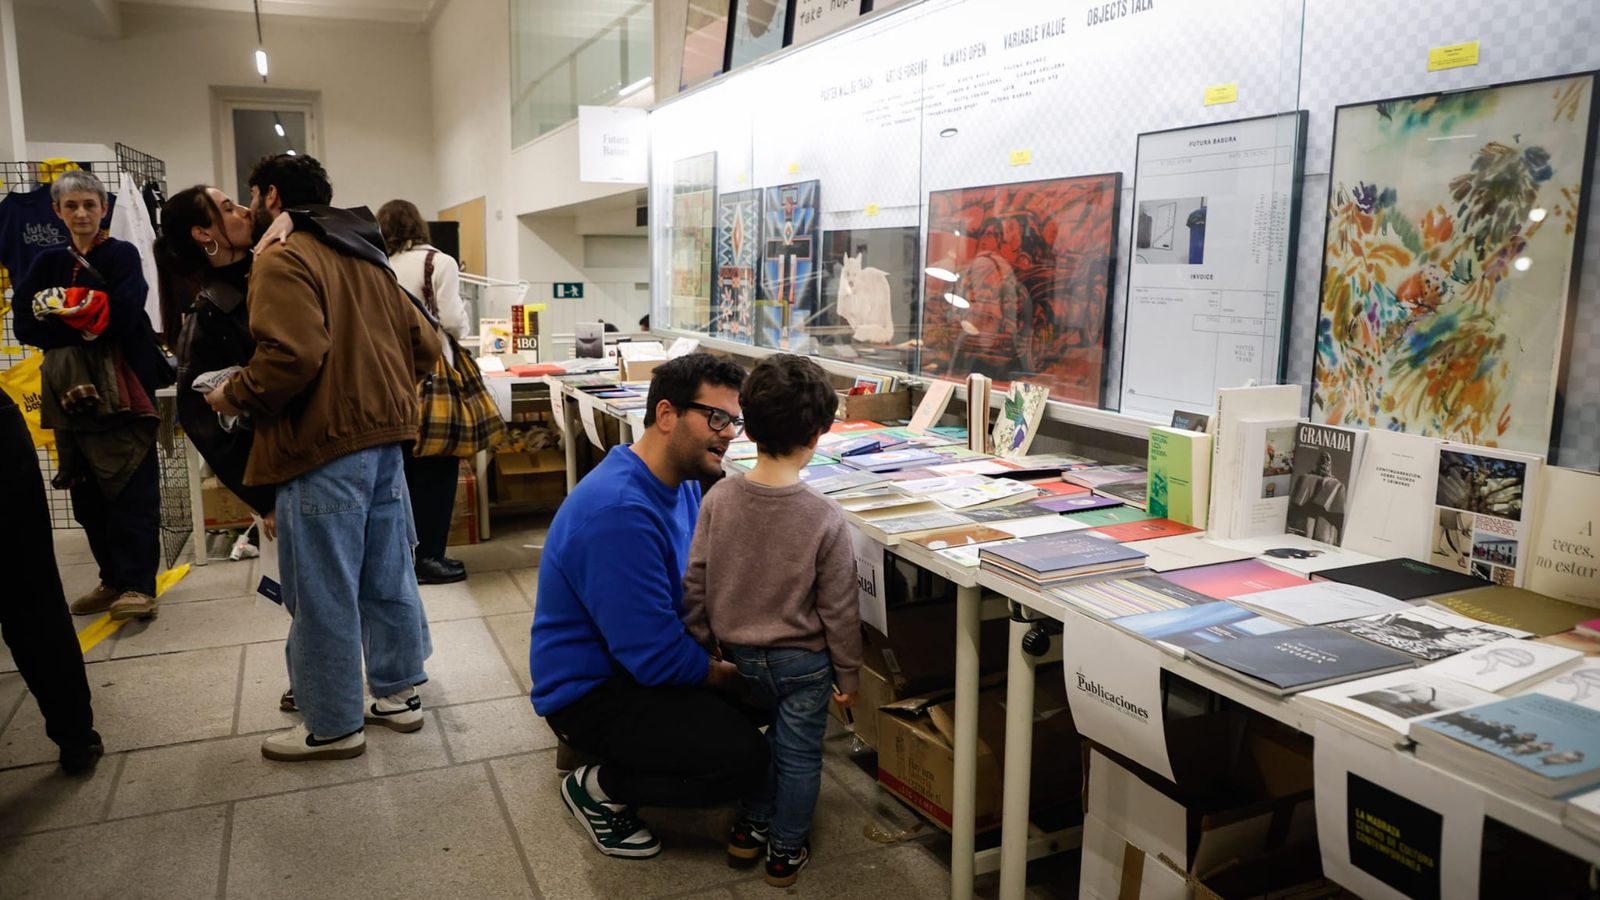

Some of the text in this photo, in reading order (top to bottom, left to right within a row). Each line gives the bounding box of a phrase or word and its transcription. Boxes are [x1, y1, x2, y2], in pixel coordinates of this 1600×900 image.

[1087, 0, 1154, 26] OBJECTS TALK
[1003, 17, 1066, 50] VARIABLE VALUE
[968, 41, 987, 61] OPEN
[1190, 273, 1214, 281] INVOICE
[1300, 426, 1351, 452] GRANADA
[1475, 515, 1514, 529] BERNARD
[1579, 520, 1592, 536] A
[1536, 556, 1598, 578] no estar
[1077, 675, 1149, 719] Publicaciones
[1355, 807, 1401, 839] LA MADRAZA
[1355, 819, 1435, 868] CENTRO DE CULTURA
